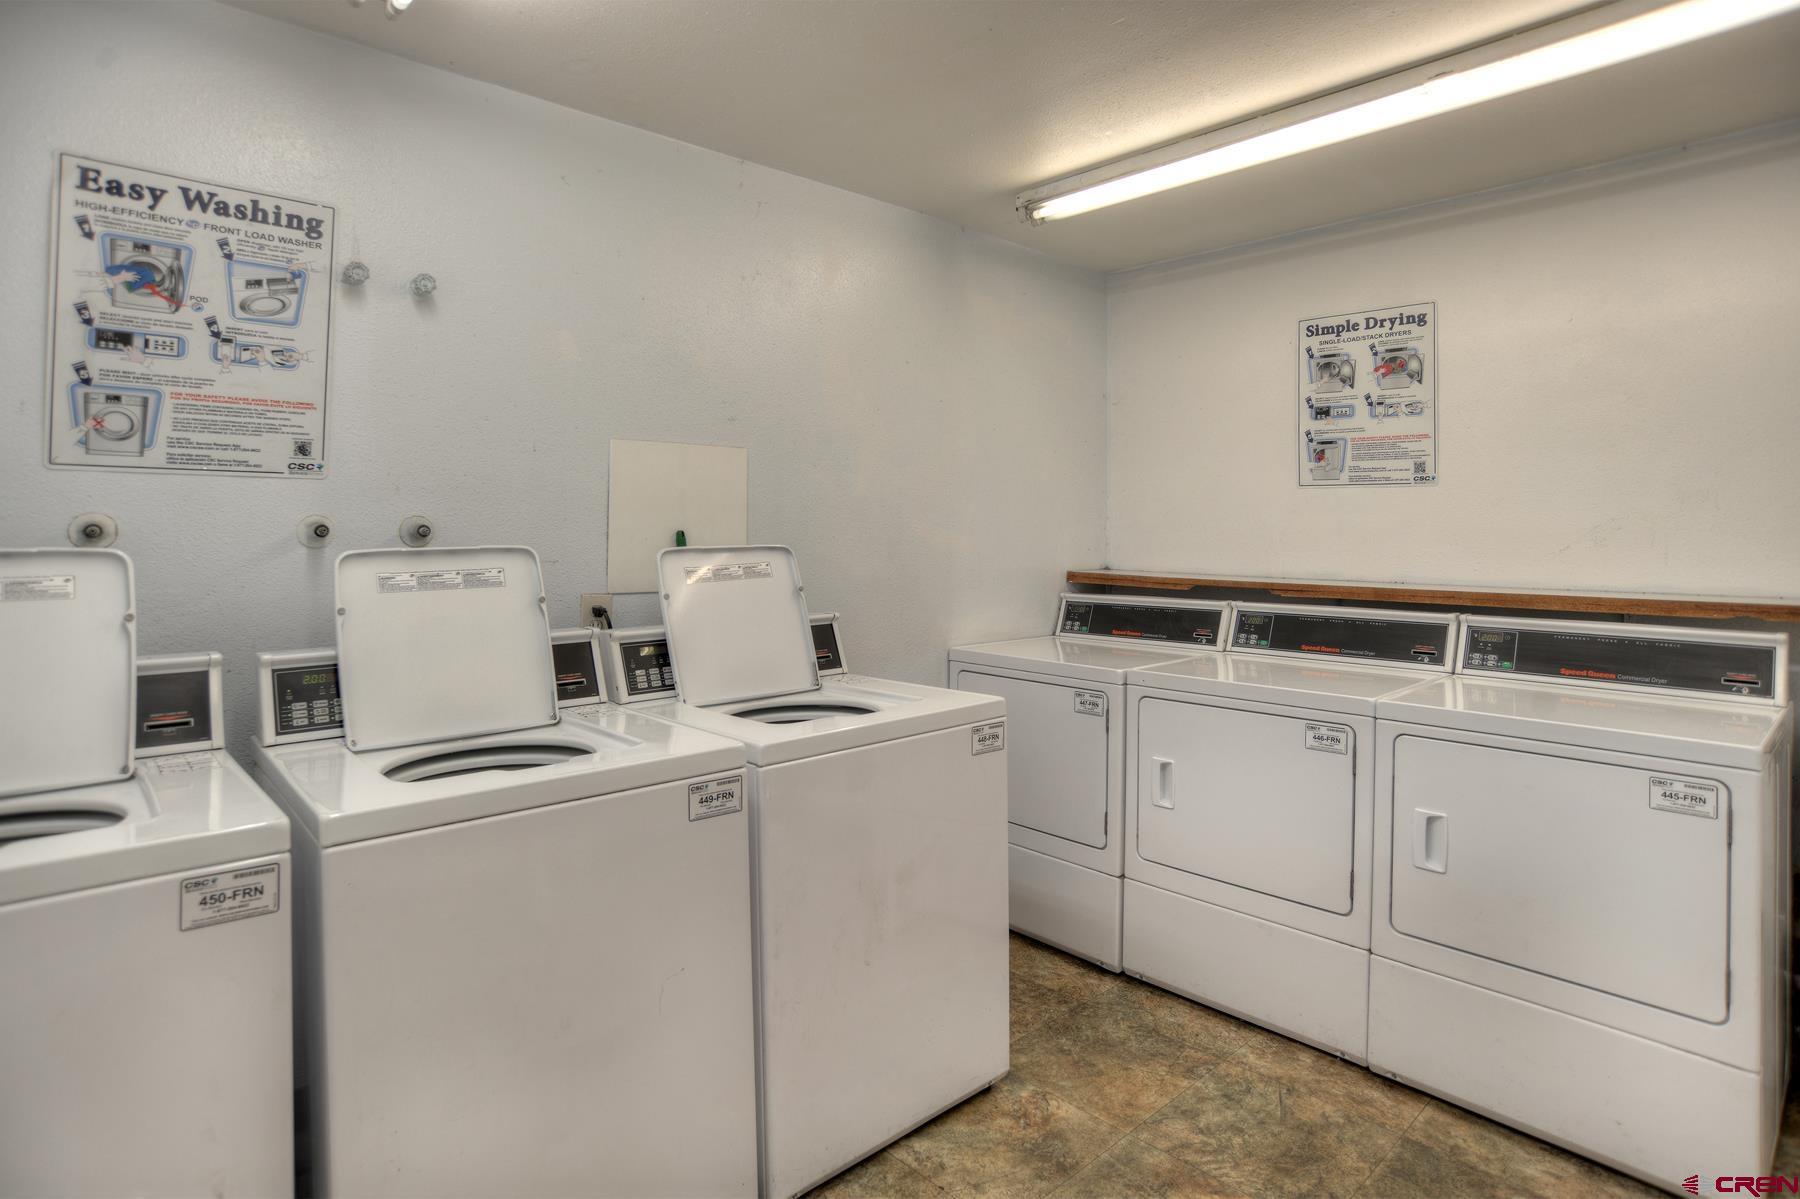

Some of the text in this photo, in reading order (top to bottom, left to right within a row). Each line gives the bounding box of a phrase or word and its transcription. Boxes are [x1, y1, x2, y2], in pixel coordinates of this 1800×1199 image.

[75, 164, 169, 212] Easy
[177, 185, 325, 240] Washing
[75, 199, 184, 226] HIGH-EFFICIENCY
[203, 222, 242, 236] FRONT
[244, 230, 275, 242] LOAD
[277, 236, 323, 249] WASHER
[189, 295, 209, 303] POD
[1305, 311, 1428, 338] Simple Drying
[1384, 329, 1412, 338] DRYERS
[287, 462, 315, 471] CSC
[1560, 667, 1668, 684] Speed Queen Commercial Dryer
[1312, 734, 1341, 744] 446-FRN
[698, 790, 735, 805] 449-FRN
[1660, 791, 1707, 805] 445-FRN
[199, 884, 265, 907] 450-FRN
